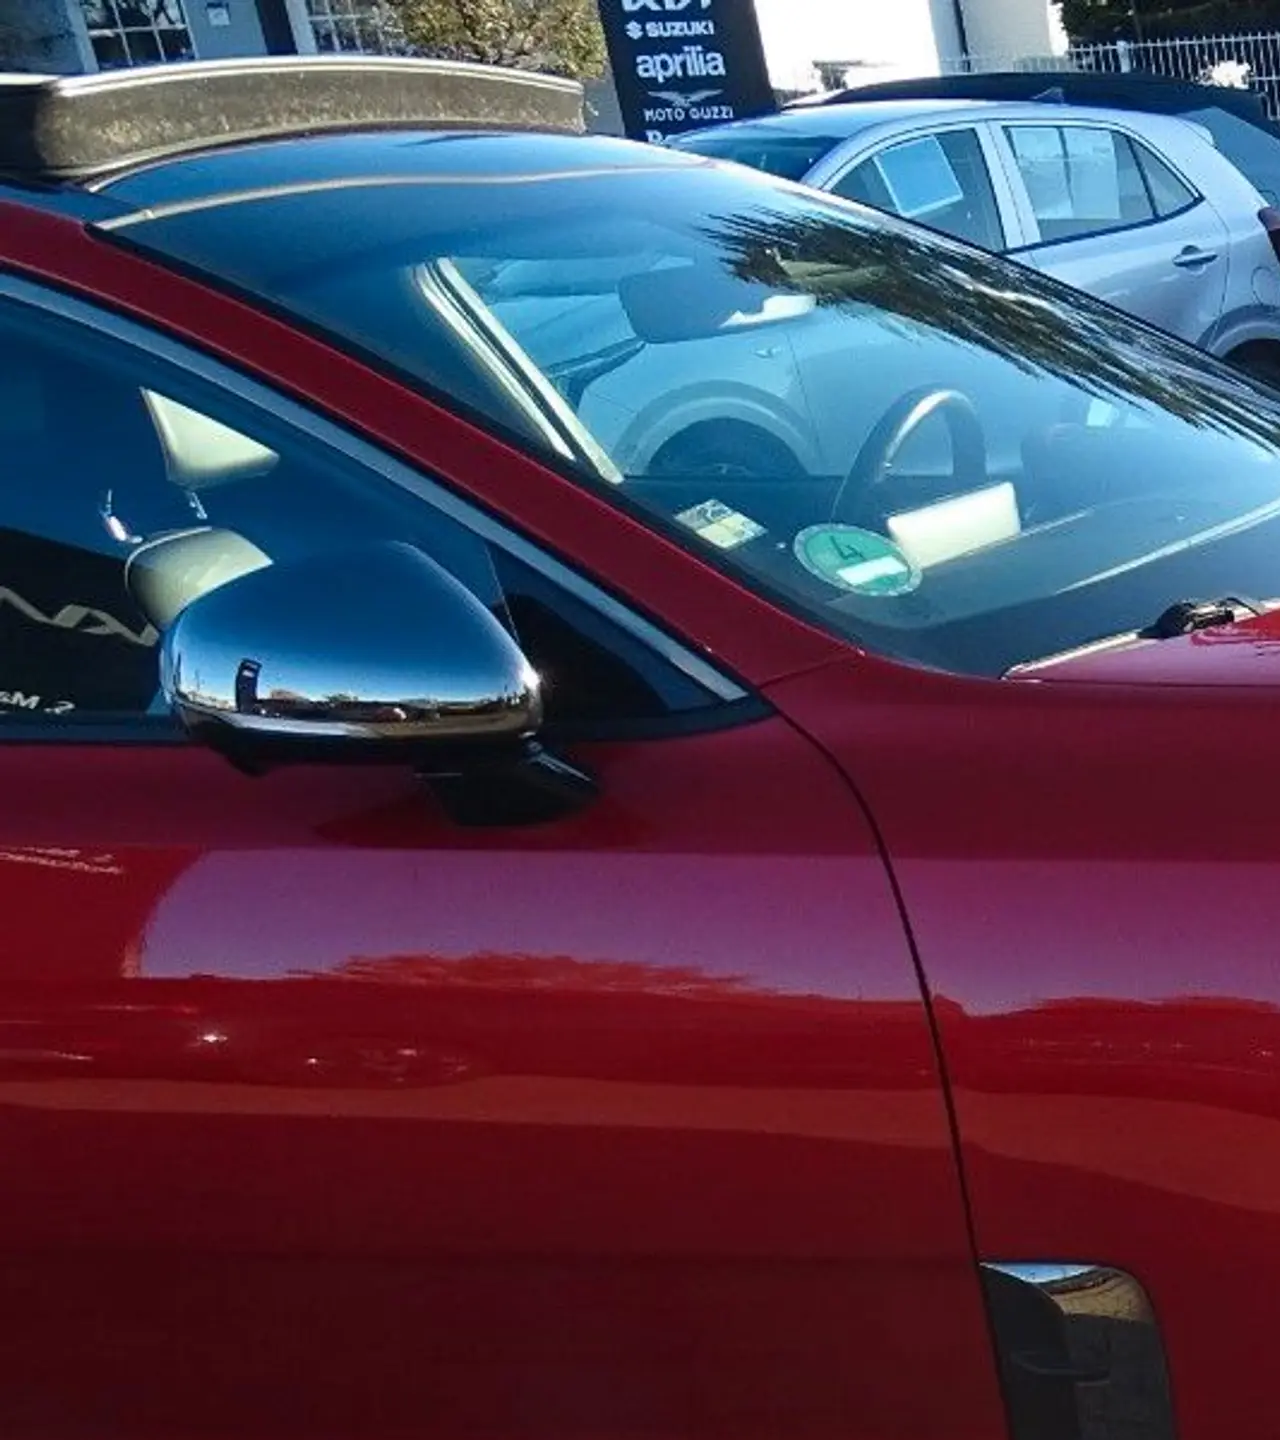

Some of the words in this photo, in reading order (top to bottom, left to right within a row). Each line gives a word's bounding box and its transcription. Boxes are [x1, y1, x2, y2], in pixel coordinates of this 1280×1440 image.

[645, 20, 714, 38] SUZUKI
[636, 45, 726, 83] aprilia
[644, 107, 685, 122] MOTO
